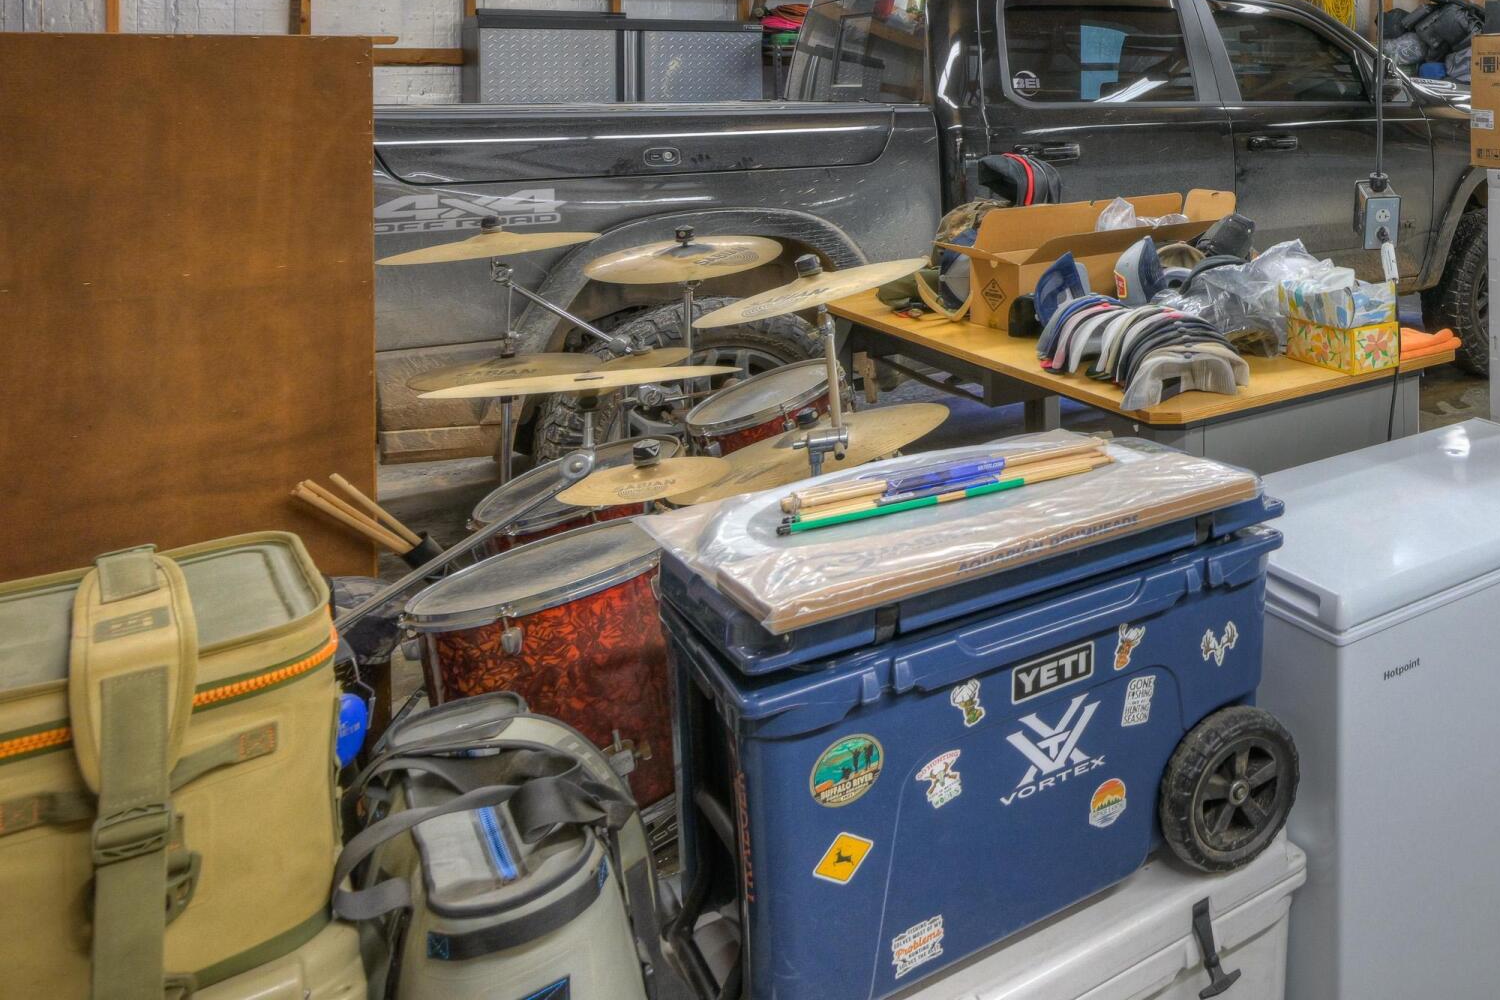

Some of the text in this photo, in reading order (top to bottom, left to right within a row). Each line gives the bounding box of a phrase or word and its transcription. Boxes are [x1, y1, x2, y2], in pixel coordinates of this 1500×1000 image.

[1016, 650, 1091, 694] YETI
[1383, 657, 1421, 681] Hotpoint
[1129, 677, 1154, 691] GONE
[1124, 712, 1149, 723] SEASON
[820, 782, 852, 801] BUFFALO
[852, 771, 874, 788] RIVER
[999, 755, 1107, 807] VORTEX
